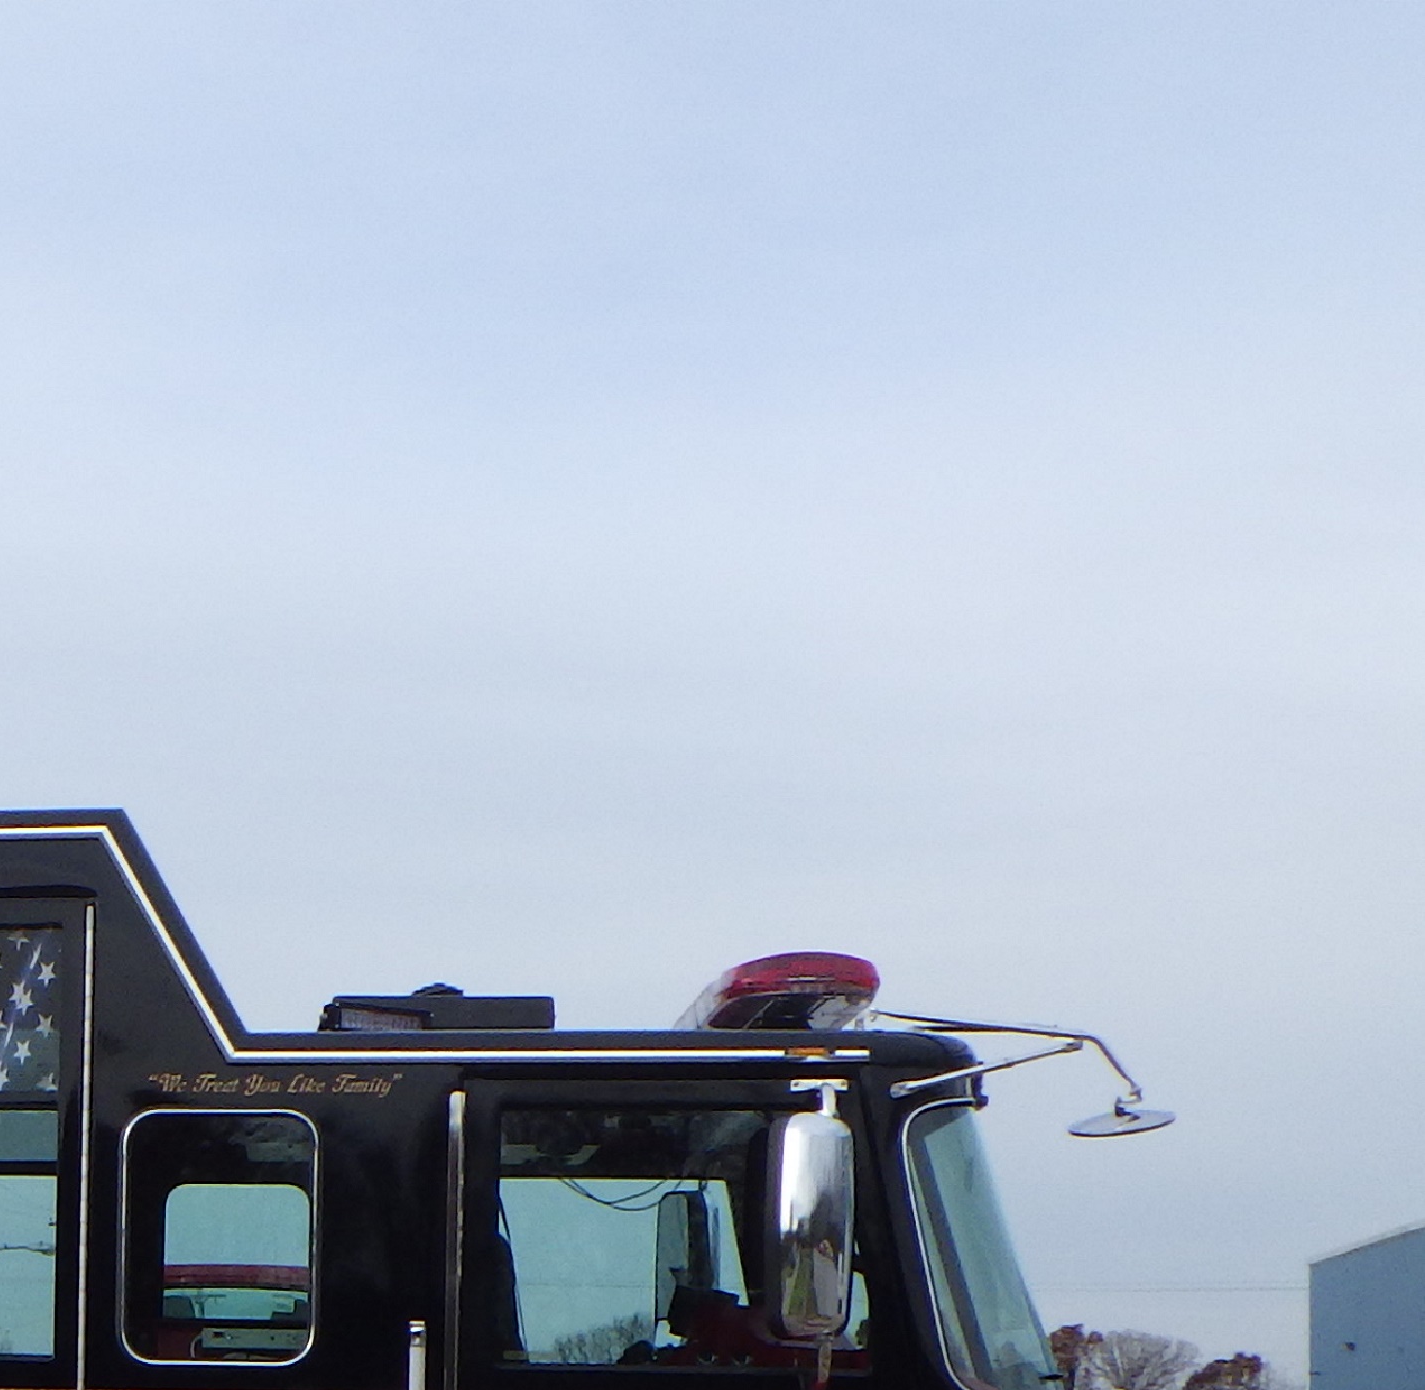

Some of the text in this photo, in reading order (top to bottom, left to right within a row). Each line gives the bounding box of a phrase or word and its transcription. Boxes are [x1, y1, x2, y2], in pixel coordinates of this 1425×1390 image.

[193, 1073, 238, 1093] Treat
[244, 1073, 281, 1097] You
[287, 1073, 326, 1093] Like
